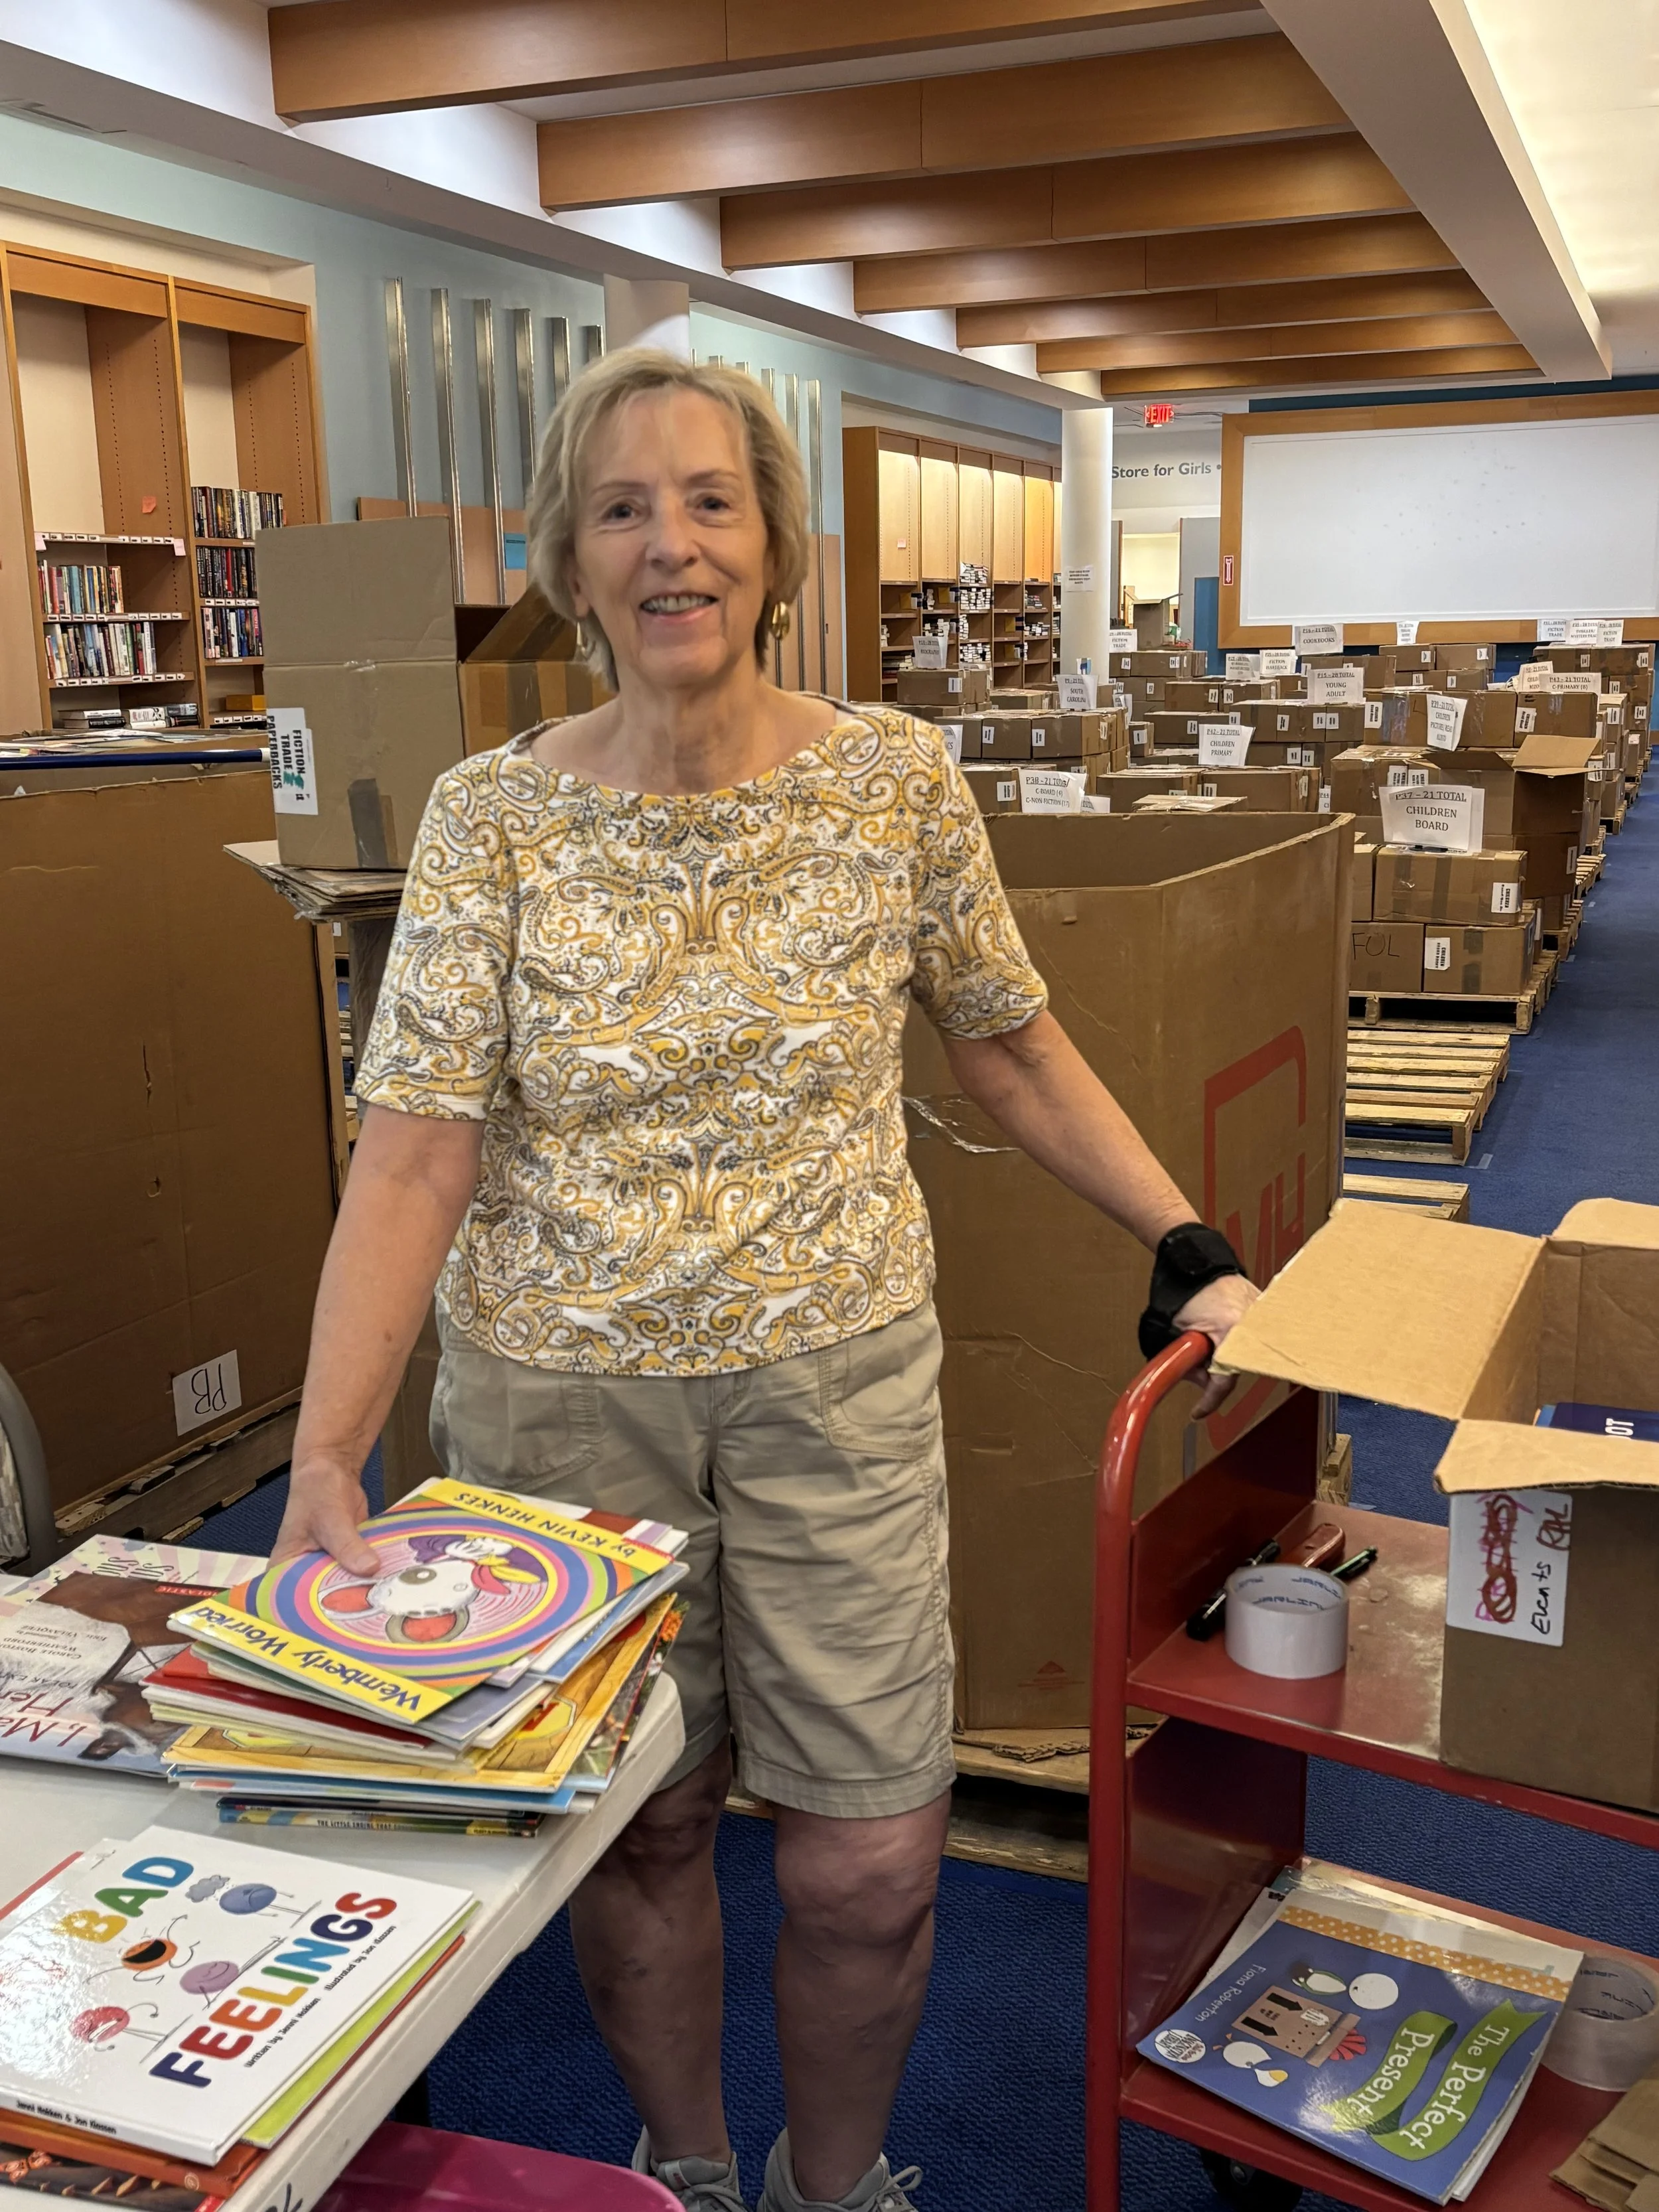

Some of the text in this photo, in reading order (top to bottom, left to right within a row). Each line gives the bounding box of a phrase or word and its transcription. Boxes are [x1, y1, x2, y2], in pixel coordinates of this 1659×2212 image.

[1150, 406, 1172, 423] EXIT
[1112, 462, 1211, 479] Store for Girls
[267, 715, 283, 790] PAPERBACKS
[281, 733, 293, 770] TRADE
[293, 730, 306, 774] FICTION
[1026, 797, 1061, 806] C-NON-FICTION
[1396, 792, 1413, 800] P37
[1437, 791, 1467, 802] TOTAL
[1406, 806, 1457, 818] CHILDREN
[1415, 820, 1449, 831] BOARD
[1351, 932, 1400, 960] FOL
[190, 1363, 228, 1415] PB
[1605, 1418, 1634, 1440] OT
[454, 1493, 637, 1558] by KEVIN HENKES
[3, 1637, 77, 1652] WEATHERFORD
[41, 1649, 82, 1660] CAROLE
[188, 1606, 422, 1711] Wemberly Worried
[54, 1856, 194, 1944] BAD
[323, 1962, 356, 1992] Illustrated
[354, 1955, 368, 1966] by
[362, 1945, 377, 1956] Jon
[1236, 1964, 1267, 1986] Fiona
[149, 1891, 397, 2088] FEELINGS
[1194, 1989, 1242, 2023] Roberton
[244, 2044, 272, 2068] Written
[267, 2034, 283, 2045] by
[277, 2018, 299, 2035] Jenni
[1347, 2027, 1435, 2116] Present
[1399, 2024, 1510, 2150] The Perfect
[16, 2100, 35, 2112] Jenni
[74, 2116, 88, 2127] Jon
[89, 2120, 117, 2135] Klassen
